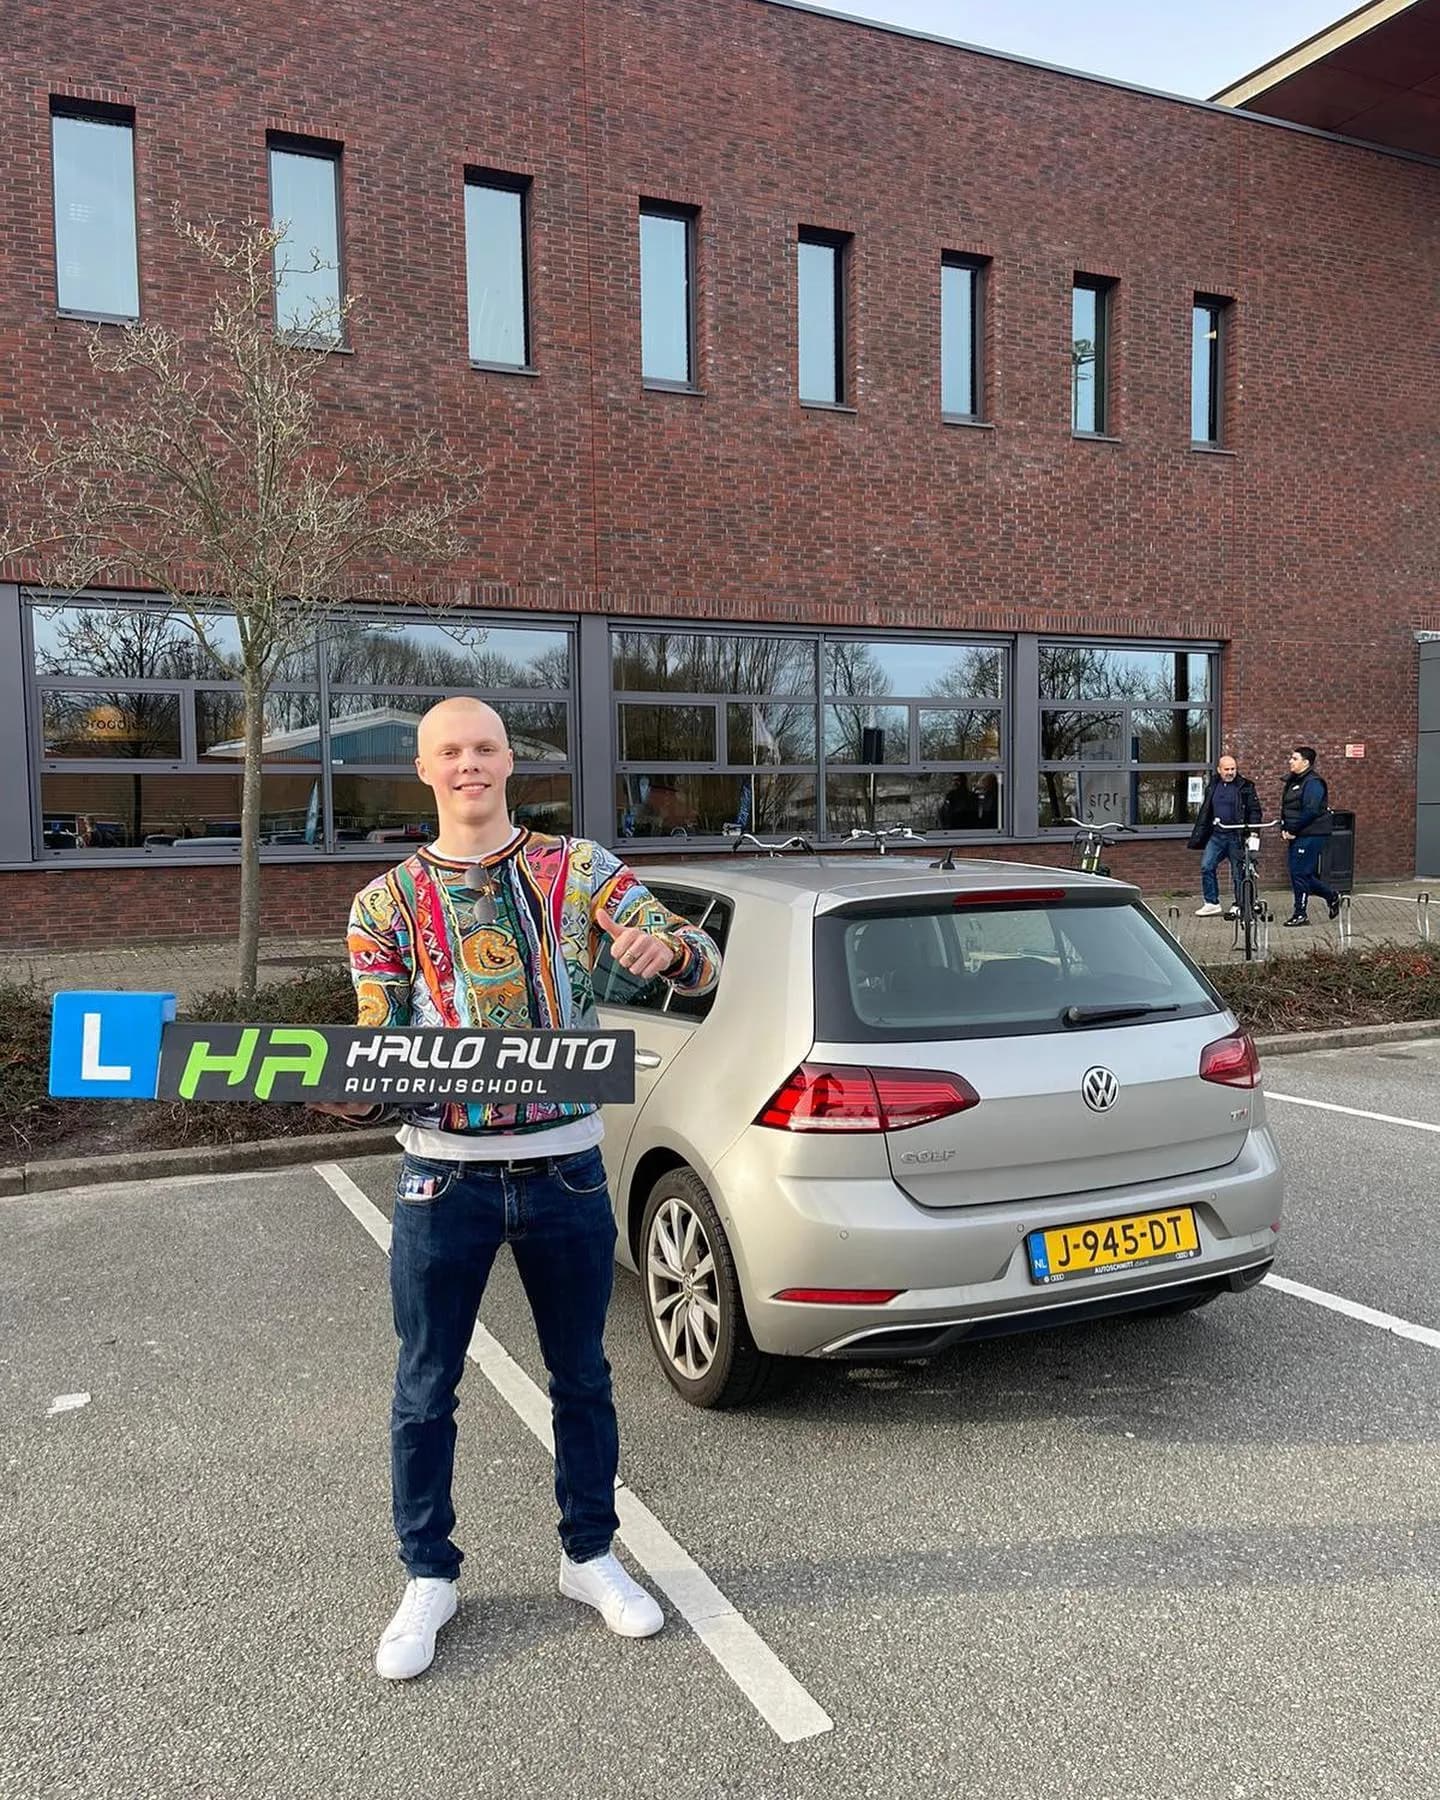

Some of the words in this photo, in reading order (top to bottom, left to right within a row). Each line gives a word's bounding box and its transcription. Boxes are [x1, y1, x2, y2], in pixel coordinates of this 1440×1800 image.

[82, 1013, 131, 1080] L
[179, 1028, 328, 1100] HA
[346, 1035, 486, 1069] HALLO
[496, 1037, 617, 1070] AUTO
[345, 1078, 547, 1094] AUTORIJSCHOOL
[901, 1150, 956, 1164] GOLF
[1058, 1215, 1182, 1267] J-945-DT
[1034, 1258, 1047, 1269] NL
